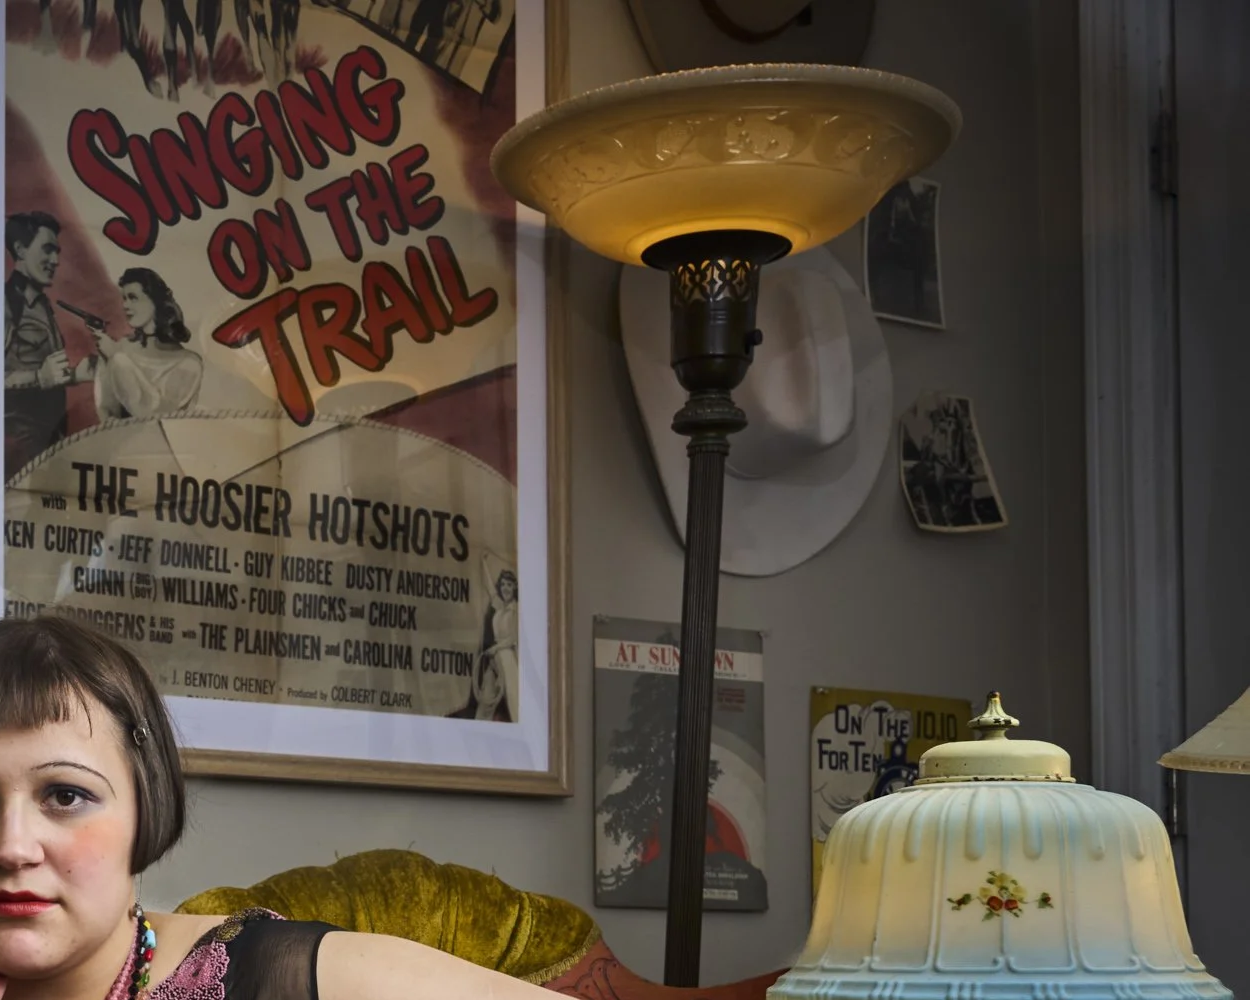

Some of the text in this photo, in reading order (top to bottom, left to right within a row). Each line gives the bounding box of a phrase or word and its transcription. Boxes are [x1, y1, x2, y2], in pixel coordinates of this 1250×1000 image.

[67, 45, 406, 255] SINGING
[208, 143, 445, 299] ON THE
[212, 235, 498, 426] TRAIL
[41, 462, 470, 562] with THE HOOSIER HOTSHOTS
[4, 519, 470, 603] KEN CURTIS JEFF DONNELL GUY KIBBEE DUSTY ANDERSON
[73, 566, 125, 597] GUINN
[161, 576, 239, 610] WILLIAMS
[248, 587, 286, 618] FOUR
[292, 593, 347, 623] CHICKS
[368, 601, 418, 631] CHUCK
[149, 630, 174, 644] BAND
[160, 616, 175, 631] HIS
[198, 622, 228, 652] THE
[234, 627, 321, 661] PLAINSMEN
[343, 638, 413, 671] CAROLINA
[421, 647, 473, 677] COTTON
[616, 641, 735, 672] AT SUNWN
[171, 669, 179, 685] J.
[184, 670, 229, 690] BENTON
[233, 675, 276, 695] CHENEY
[287, 687, 318, 700] Produced
[320, 690, 328, 702] by
[331, 686, 376, 704] COLBERT
[380, 690, 413, 708] CLARK
